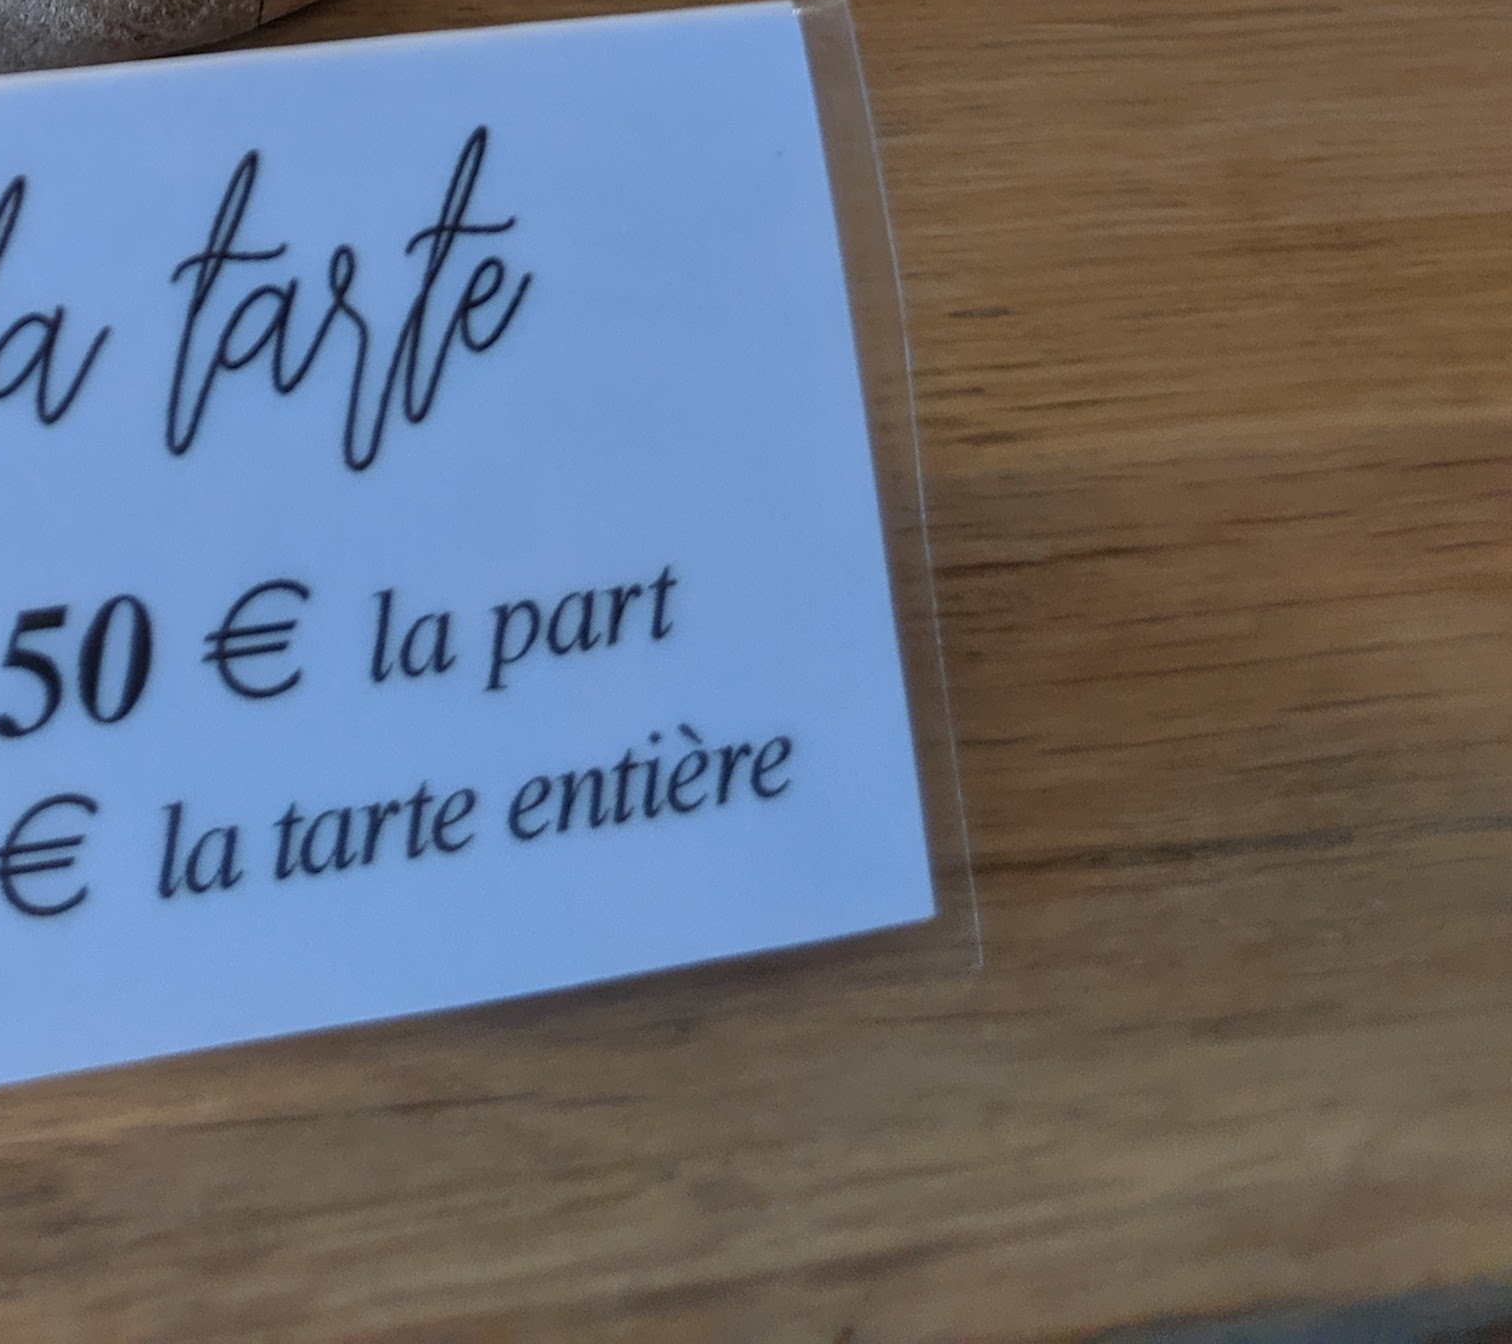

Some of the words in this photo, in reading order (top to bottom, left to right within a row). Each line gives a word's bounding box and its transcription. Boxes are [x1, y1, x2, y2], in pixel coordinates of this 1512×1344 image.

[164, 125, 534, 474] tarte
[201, 578, 313, 702] €
[368, 588, 458, 685] la
[483, 565, 678, 693] part
[156, 801, 245, 901] la
[273, 781, 478, 883] tarte
[507, 723, 794, 843] entière
